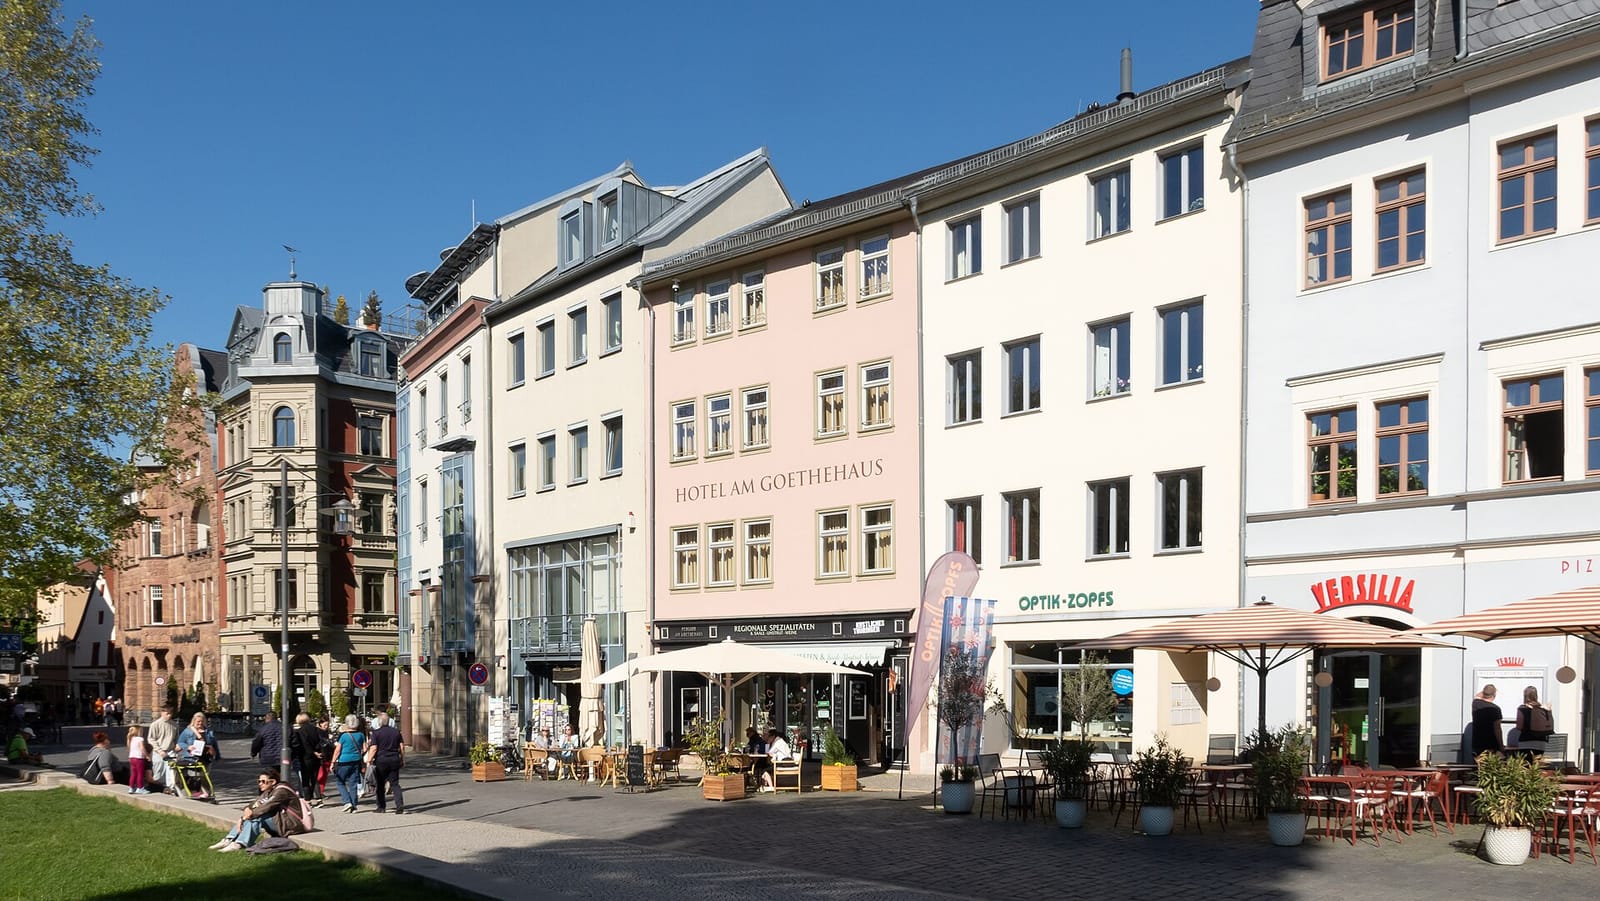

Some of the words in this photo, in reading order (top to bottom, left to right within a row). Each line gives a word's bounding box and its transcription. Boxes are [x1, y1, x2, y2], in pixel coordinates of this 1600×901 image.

[676, 483, 726, 503] HOTEL
[731, 479, 755, 497] AM
[761, 459, 884, 492] GOETHEHAUS
[1310, 574, 1416, 614] VERSILIA
[734, 624, 767, 632] REGIONALE
[921, 616, 943, 661] OPTIK
[1496, 656, 1525, 667] VERSILIA
